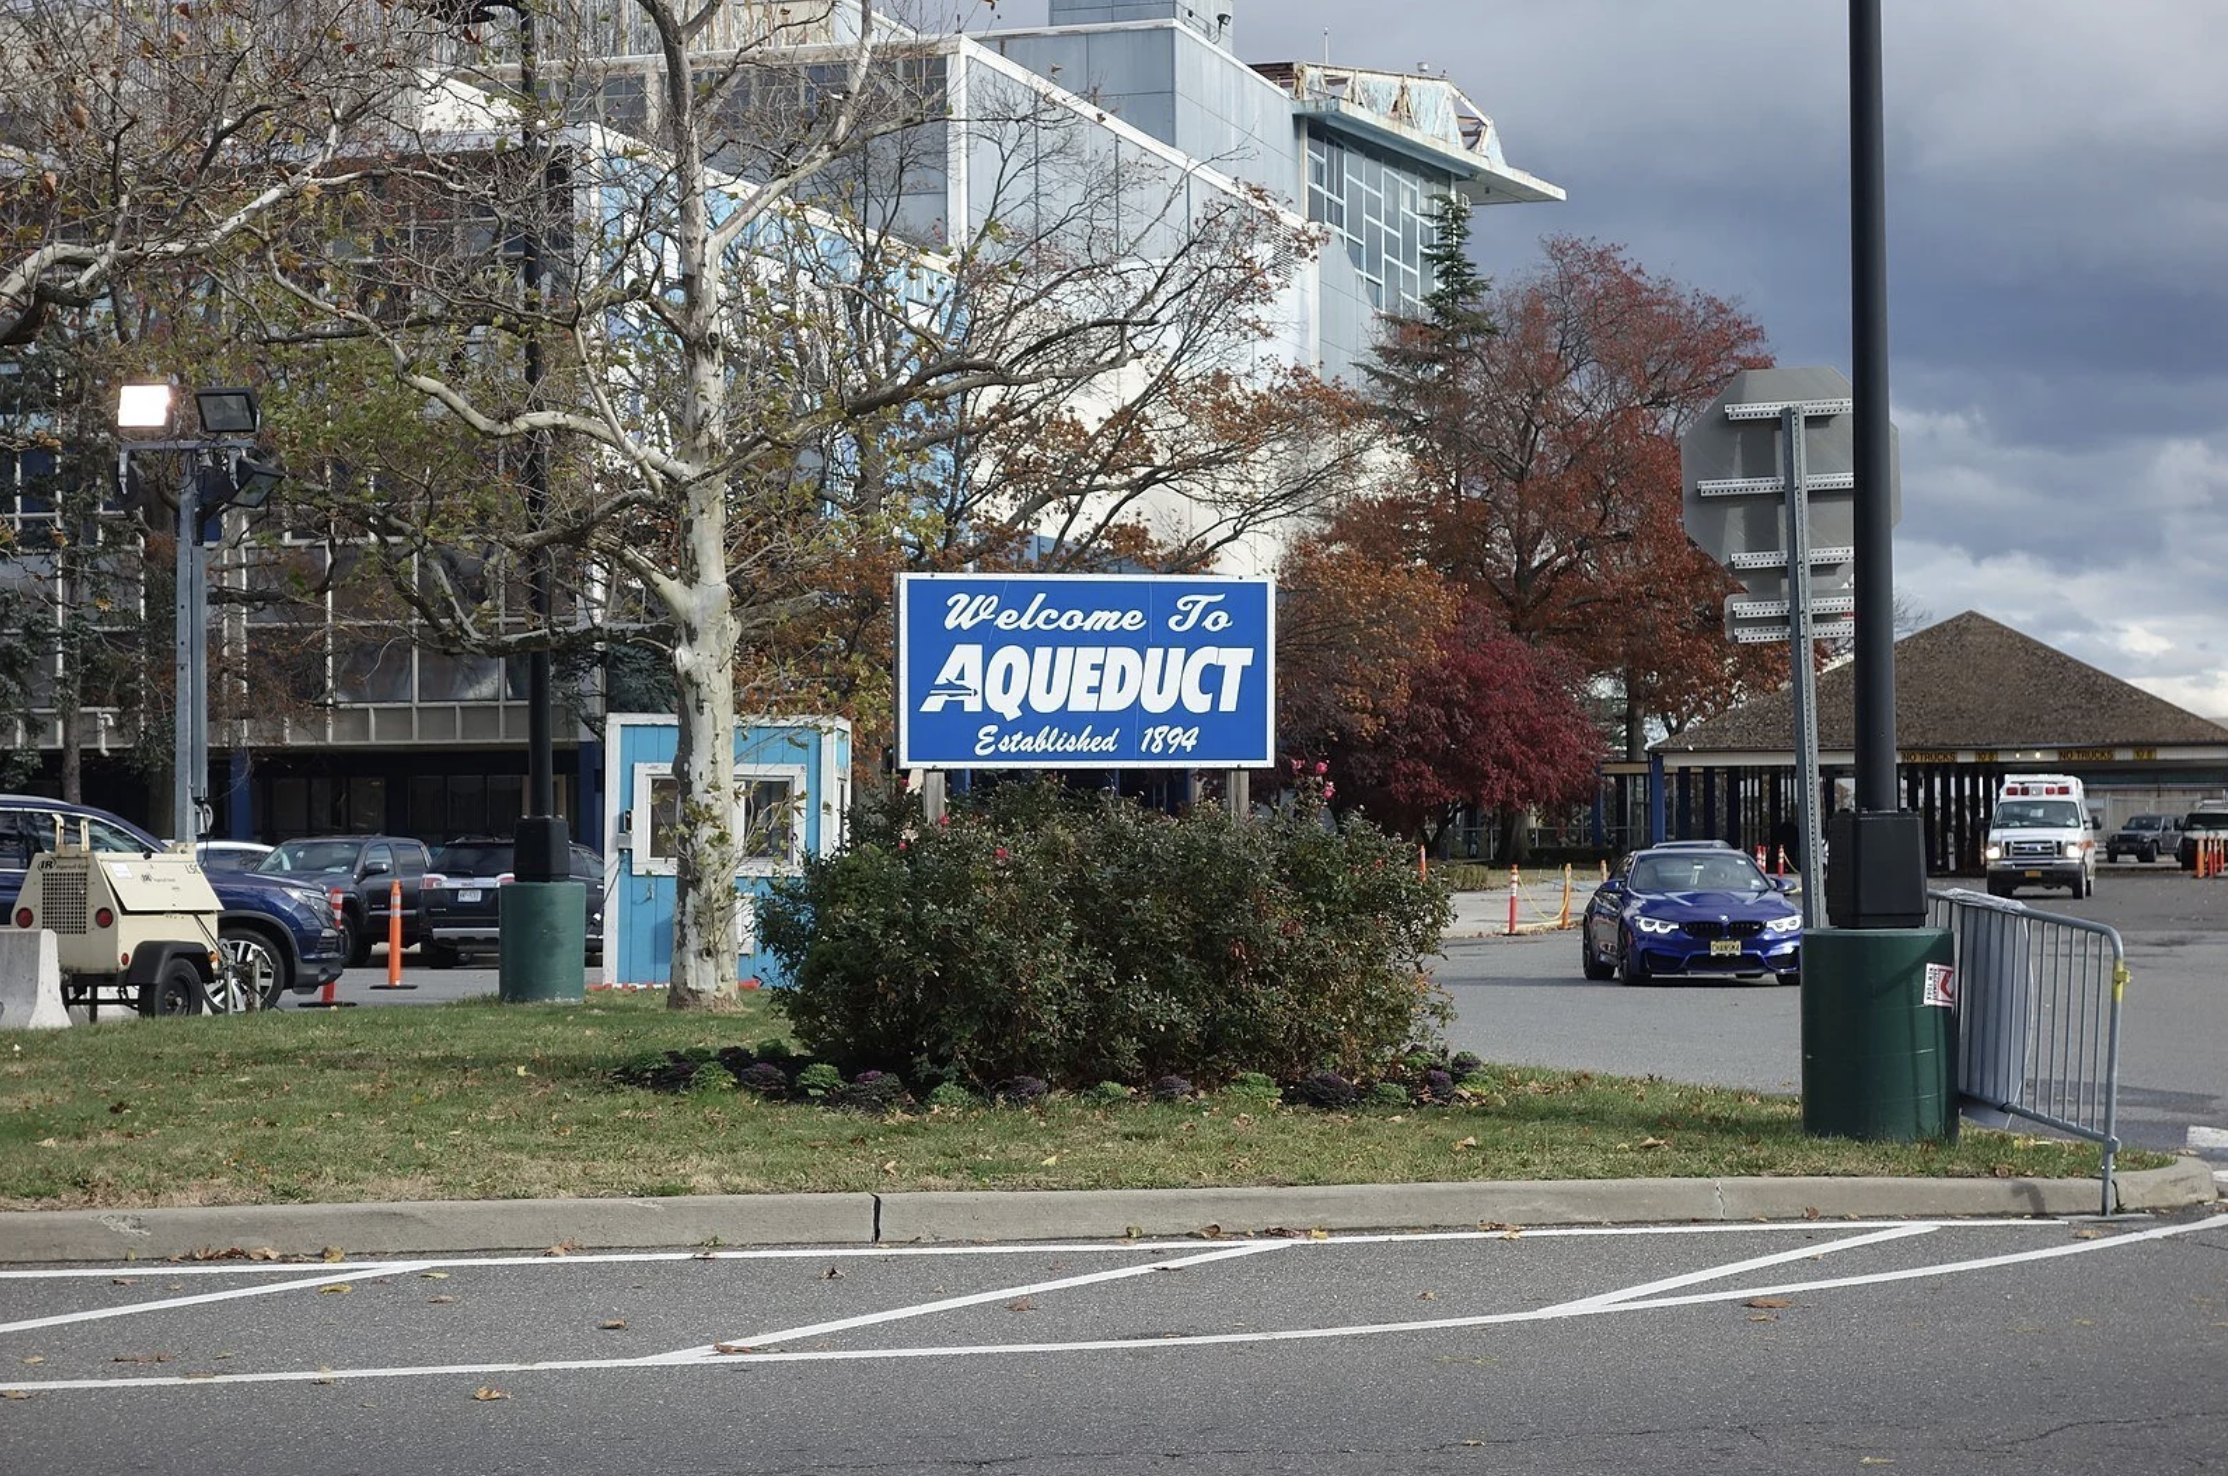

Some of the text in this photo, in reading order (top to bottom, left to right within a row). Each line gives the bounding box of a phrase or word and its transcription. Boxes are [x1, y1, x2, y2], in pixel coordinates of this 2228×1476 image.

[944, 592, 1233, 632] Welcome To
[919, 643, 1254, 721] AQUEDUCT
[974, 724, 1200, 756] Established 1894
[2060, 750, 2113, 761] NO TRUCKS
[1901, 751, 1956, 762] NO TRUCKS
